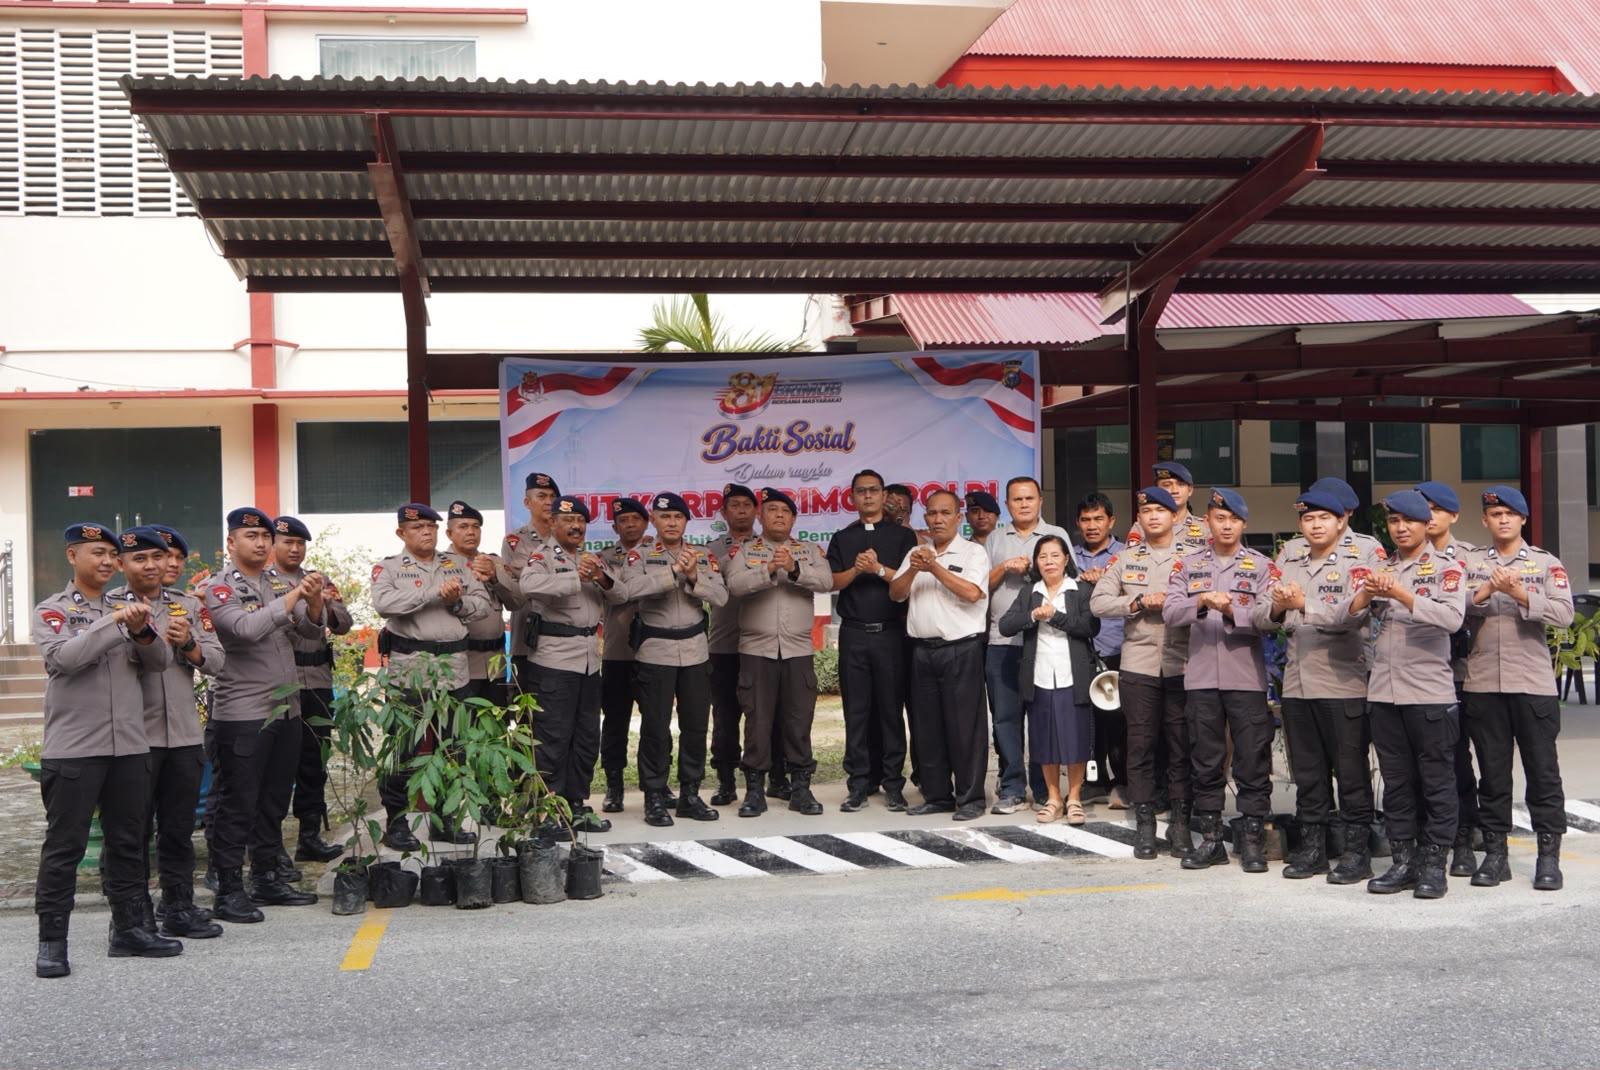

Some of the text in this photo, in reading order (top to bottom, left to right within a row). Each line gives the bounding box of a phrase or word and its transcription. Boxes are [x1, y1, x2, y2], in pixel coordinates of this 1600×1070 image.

[702, 419, 857, 463] Bakti Sosial
[1234, 571, 1258, 580] POLRI
[1413, 576, 1436, 586] POLRI
[1318, 585, 1343, 593] POLRI
